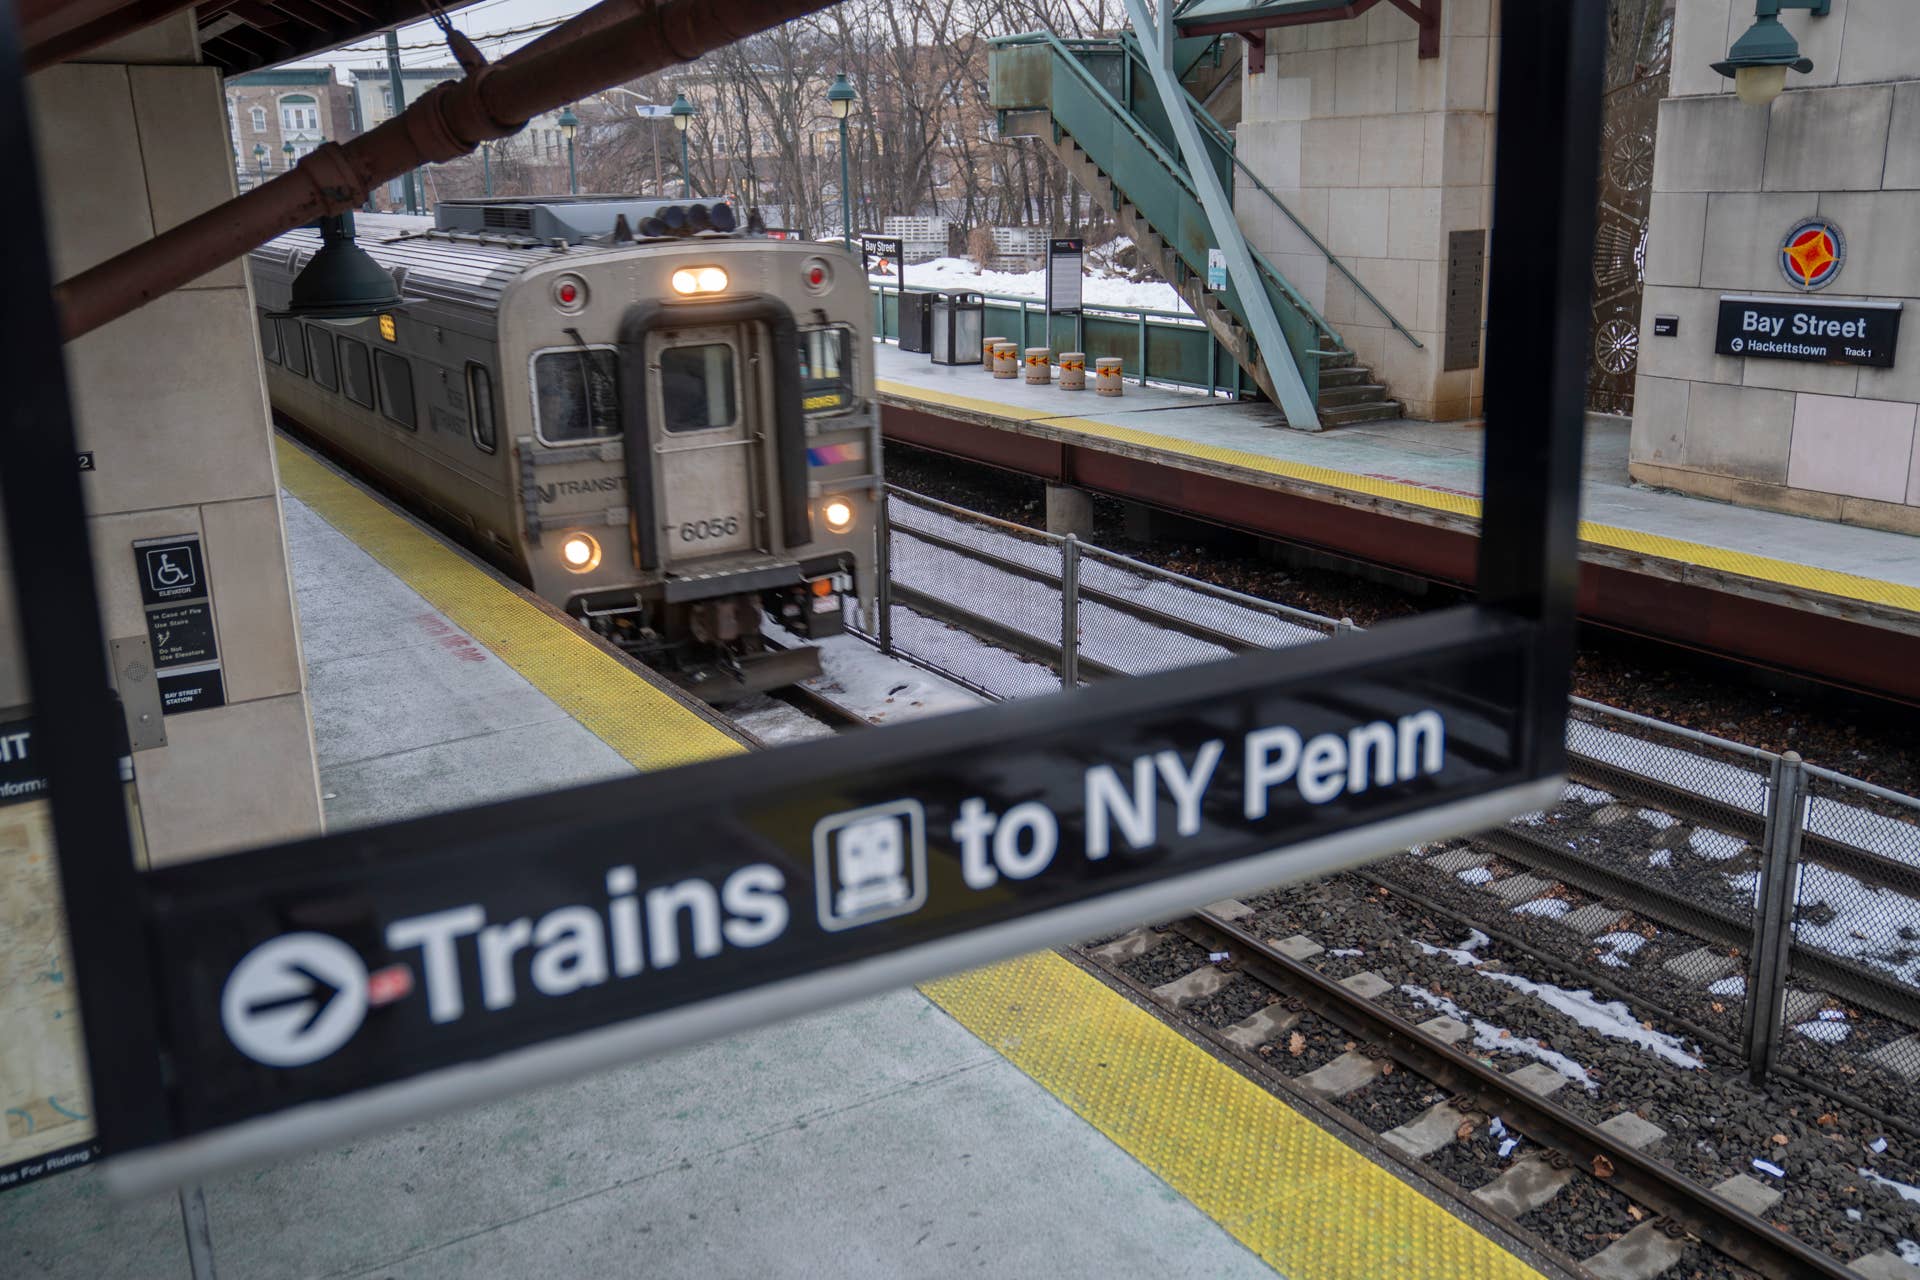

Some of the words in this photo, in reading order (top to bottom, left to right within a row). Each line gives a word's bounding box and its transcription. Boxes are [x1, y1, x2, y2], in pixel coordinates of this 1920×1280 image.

[865, 240, 877, 253] Bay
[877, 241, 896, 253] Street
[1742, 311, 1784, 337] Bay
[1792, 313, 1867, 338] Street
[1748, 340, 1827, 356] Hackettstown
[1844, 347, 1866, 357] Track
[1867, 349, 1872, 357] 1
[79, 456, 90, 468] 2
[681, 516, 738, 542] 6056
[159, 588, 191, 596] ELEVATOR
[178, 688, 202, 697] STREET
[165, 696, 193, 705] STATION
[385, 863, 793, 1025] Trains
[952, 797, 1059, 891] to
[1084, 740, 1225, 861] NY
[1243, 708, 1445, 820] Penn
[21, 1165, 43, 1178] For
[47, 1150, 89, 1170] Riding
